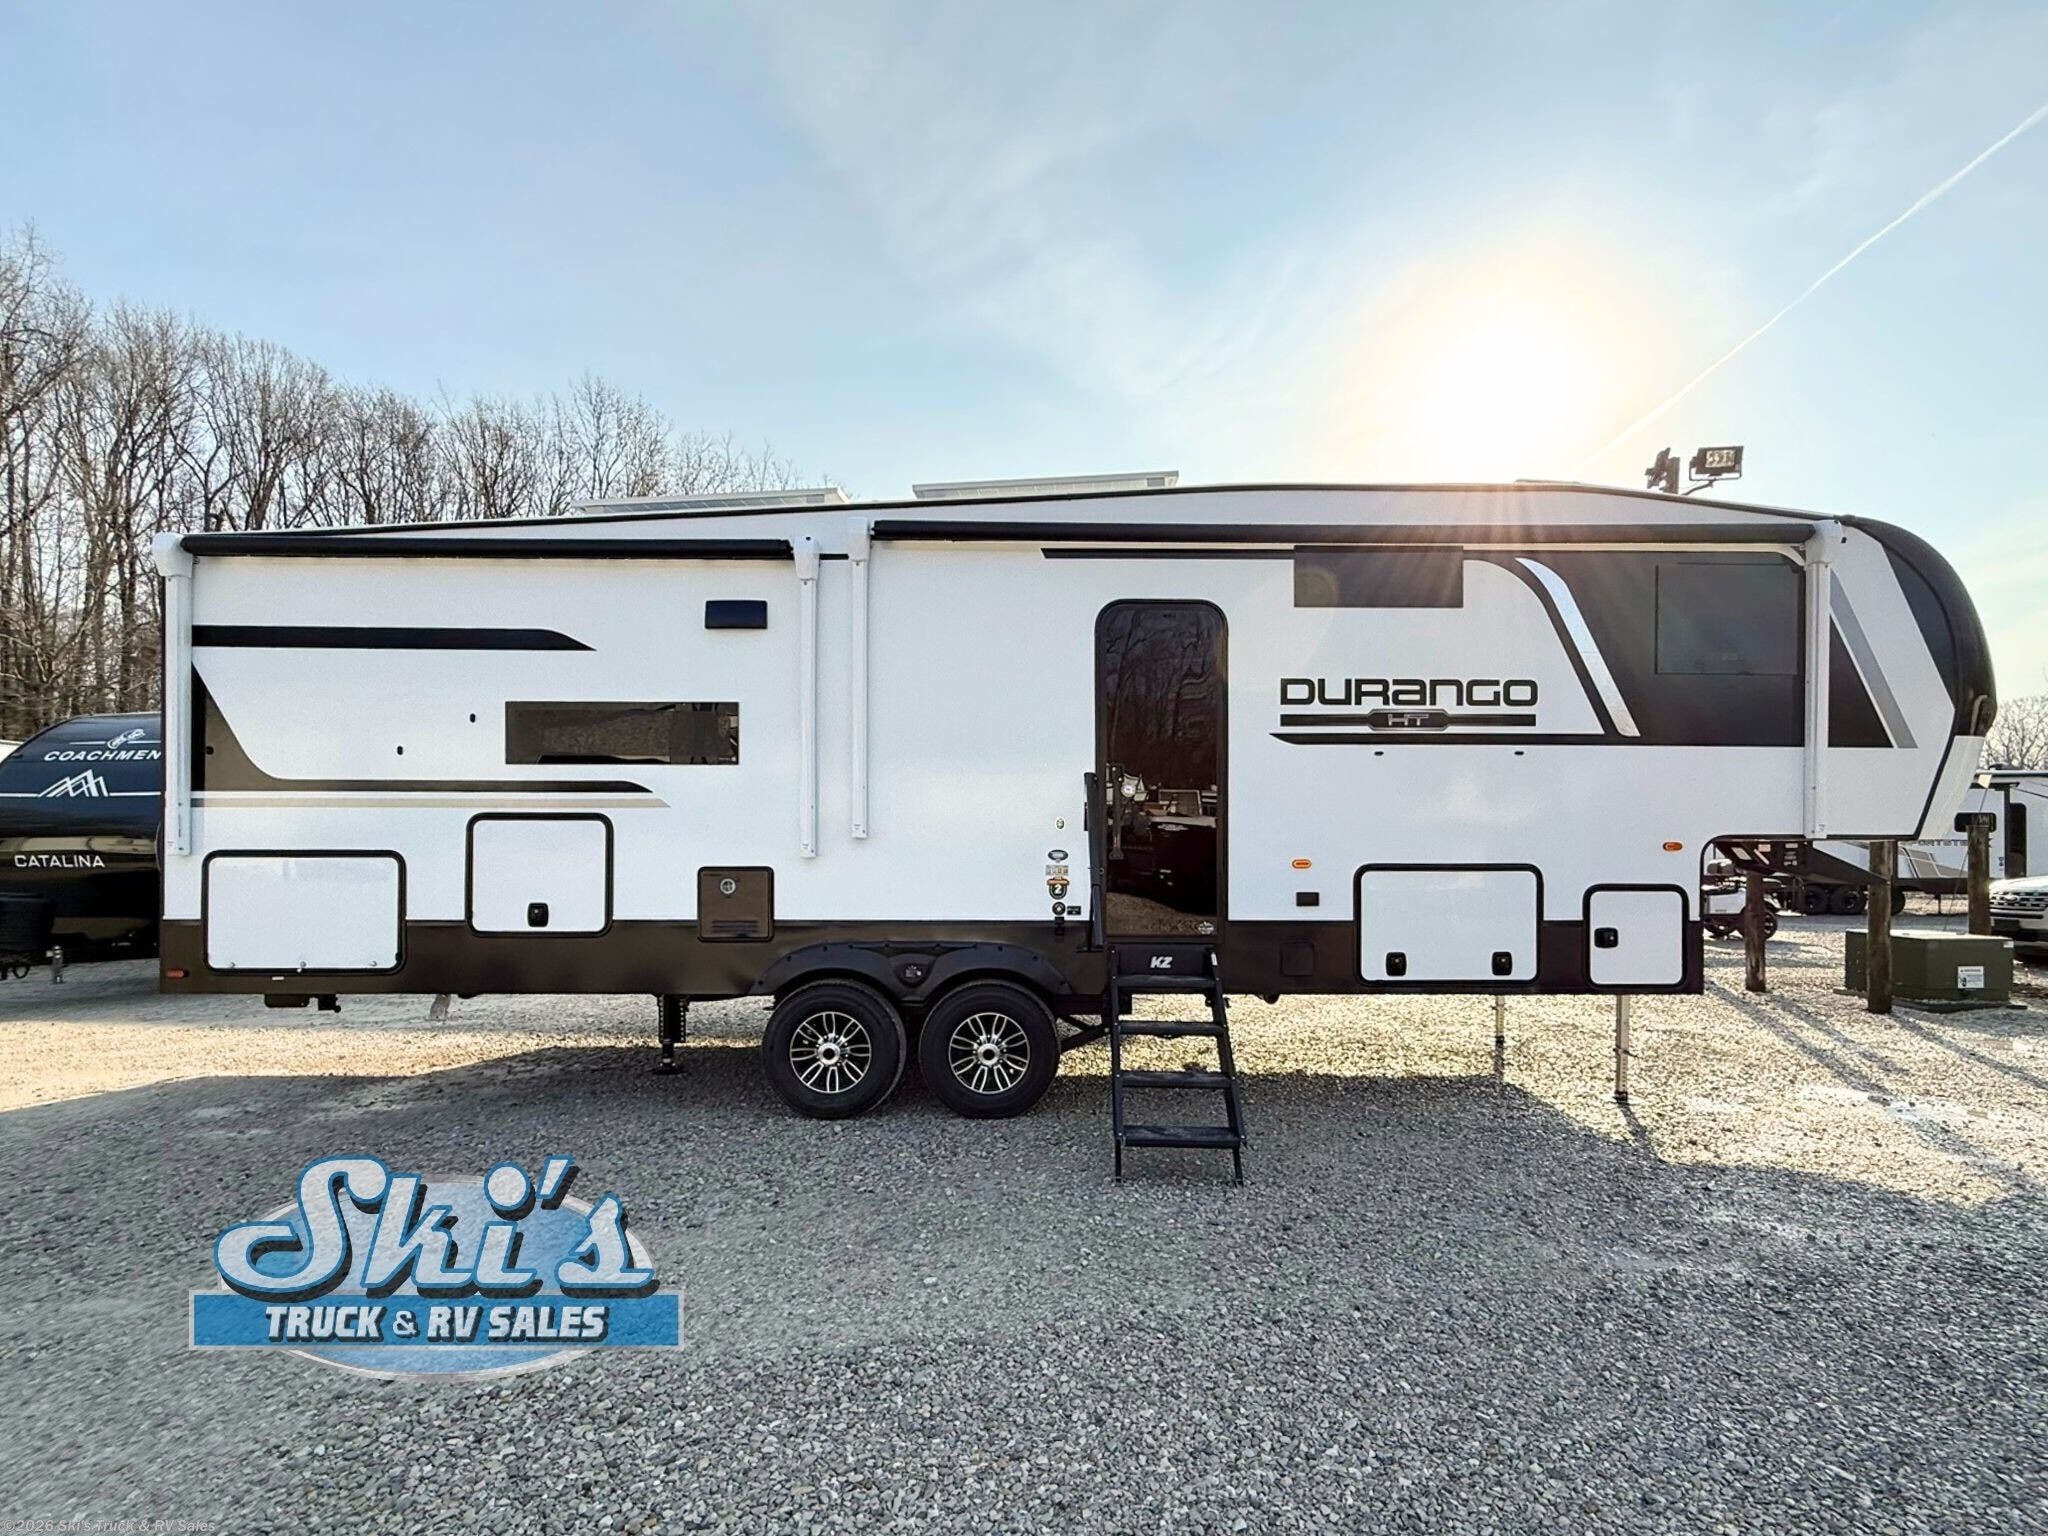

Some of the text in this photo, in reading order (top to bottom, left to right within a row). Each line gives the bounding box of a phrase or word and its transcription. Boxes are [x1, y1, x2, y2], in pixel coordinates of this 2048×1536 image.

[1280, 678, 1538, 706] DURANGO
[1387, 713, 1429, 726] HT
[44, 750, 161, 761] COACHMEN
[14, 854, 105, 868] CATALINA
[1150, 956, 1173, 969] KZ
